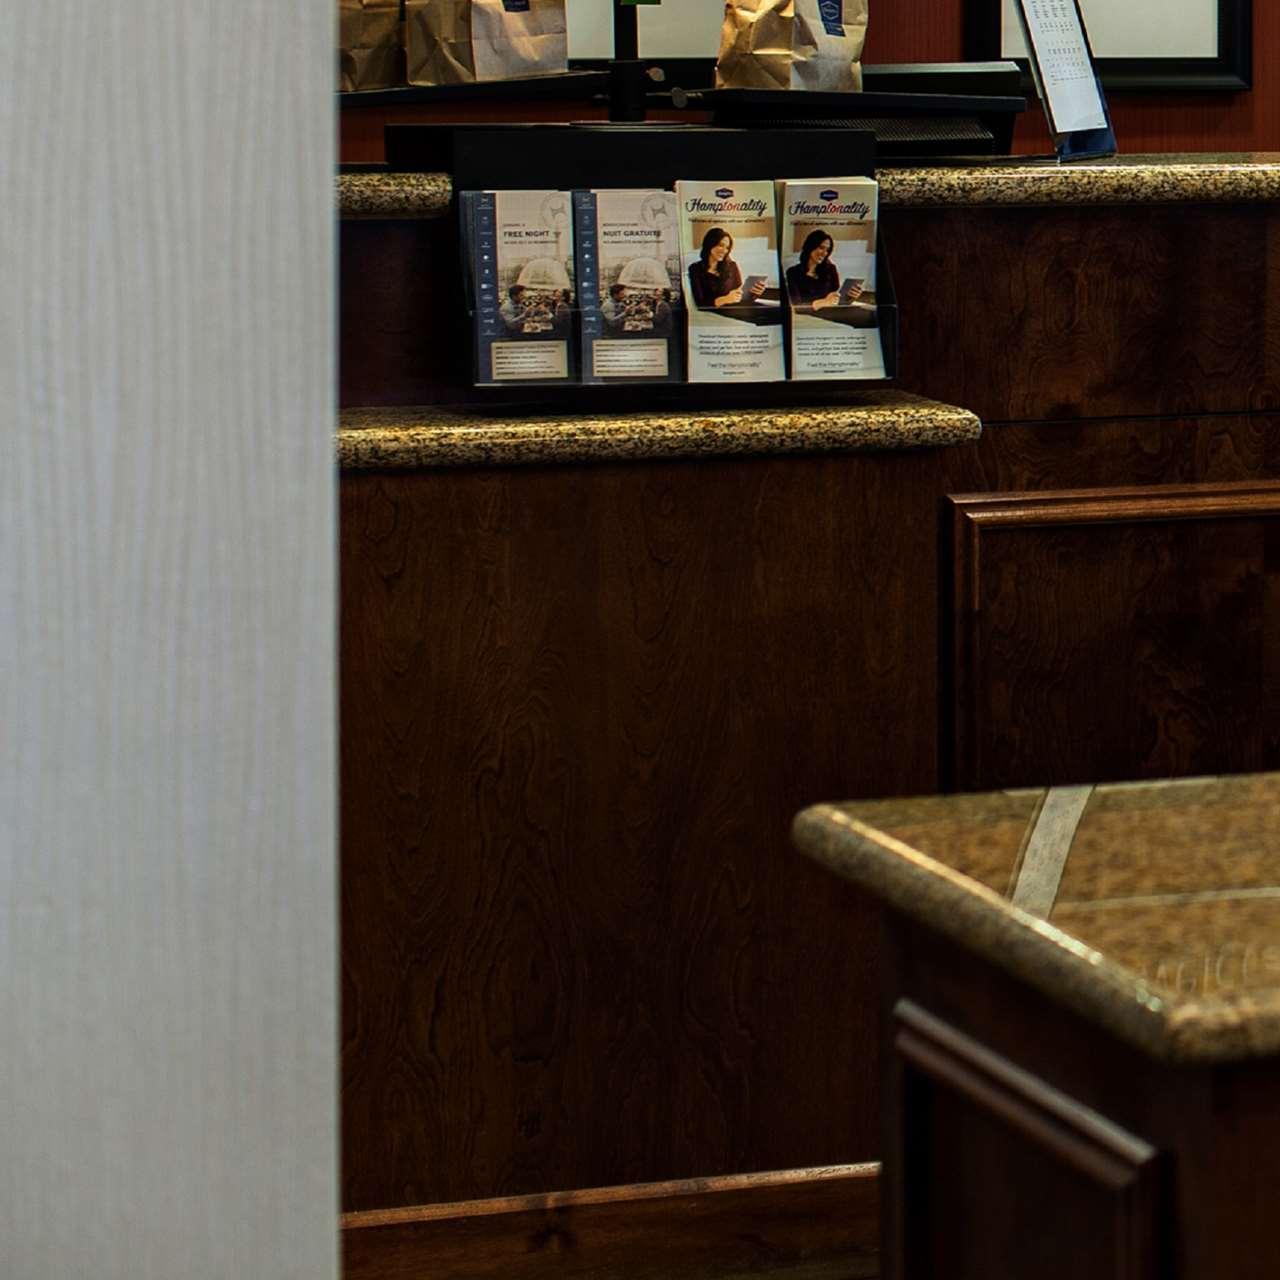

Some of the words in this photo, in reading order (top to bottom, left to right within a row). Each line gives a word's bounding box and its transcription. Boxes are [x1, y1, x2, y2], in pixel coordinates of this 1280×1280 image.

[686, 197, 768, 217] Hamptonality
[789, 200, 871, 220] Hamptonality
[503, 231, 523, 239] FREE
[525, 230, 550, 238] NIGHT
[603, 230, 622, 238] NUIT
